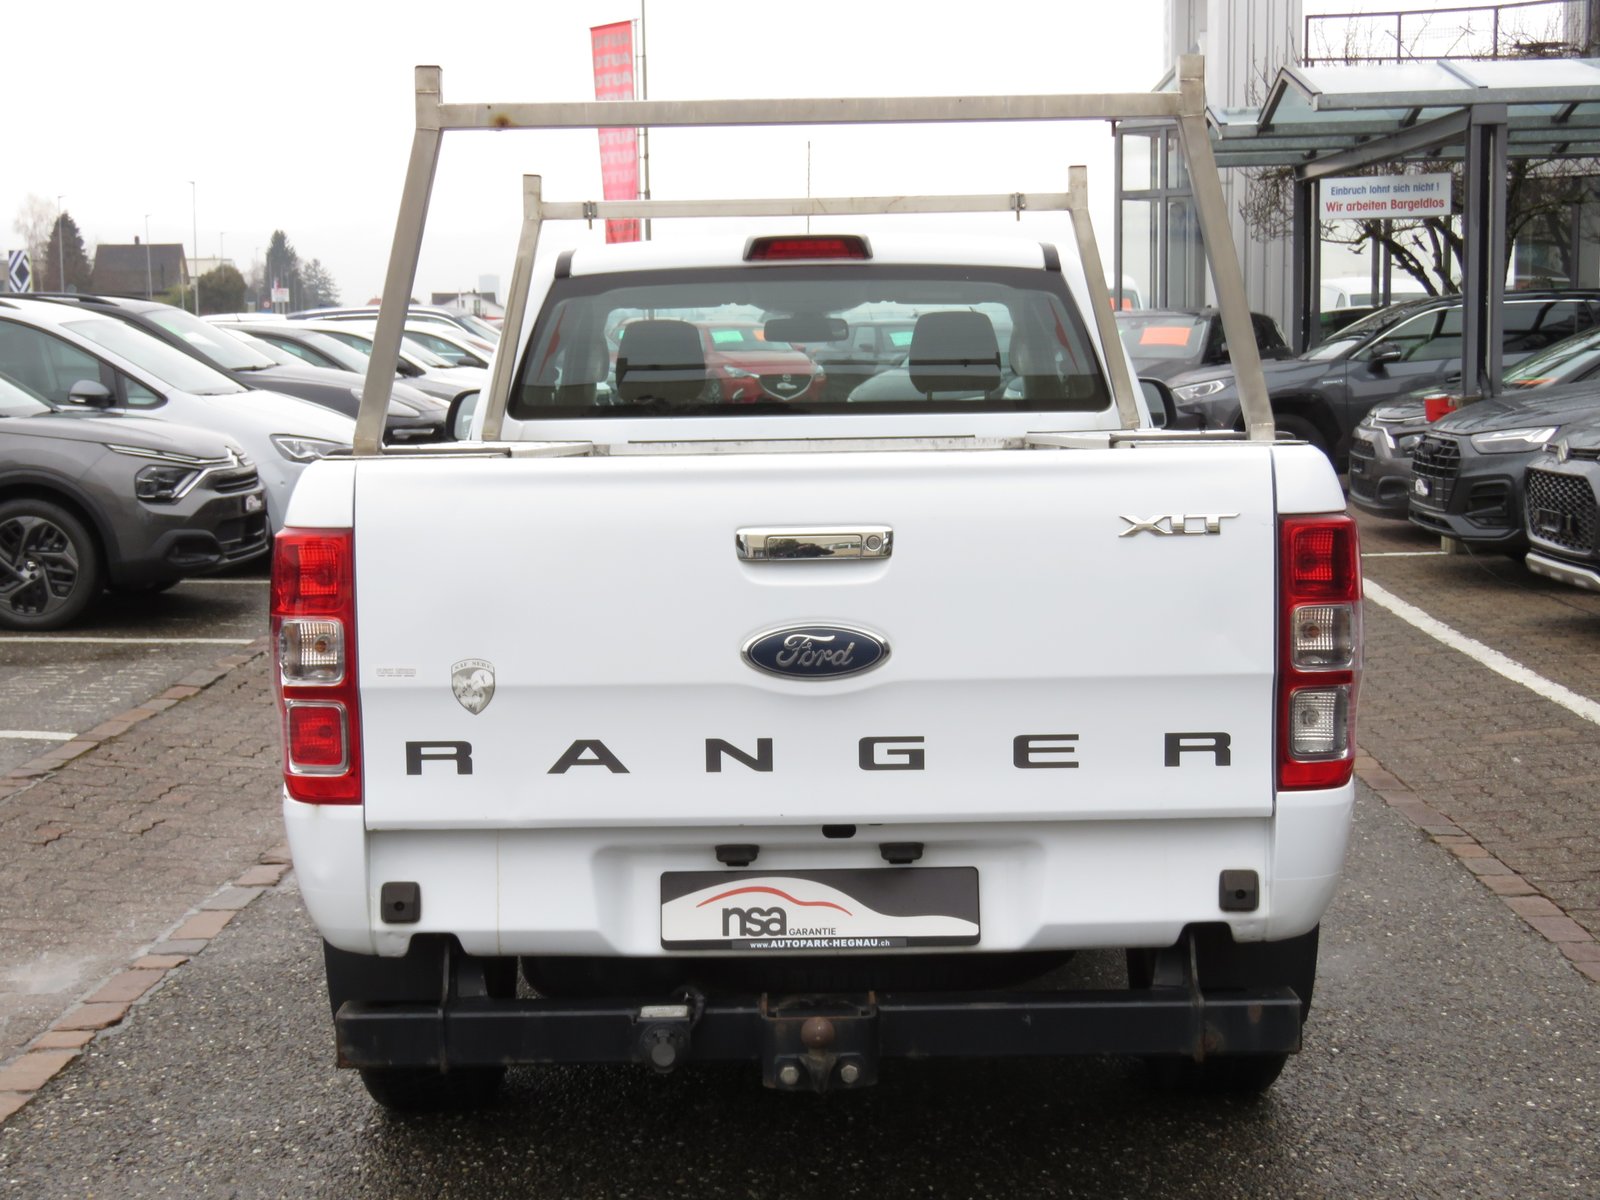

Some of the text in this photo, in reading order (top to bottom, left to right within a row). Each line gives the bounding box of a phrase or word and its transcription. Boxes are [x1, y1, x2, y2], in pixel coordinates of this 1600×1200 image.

[1330, 185, 1367, 196] Einbruch
[1369, 184, 1391, 194] lohnt
[1392, 183, 1411, 193] sich
[1413, 182, 1435, 192] nicht
[1326, 197, 1445, 212] Wir arbeiten Bargeldlos
[1118, 512, 1240, 538] XLT
[776, 633, 856, 667] Ford
[405, 732, 1231, 776] RANGER
[721, 906, 837, 937] nsa GARANTIE
[750, 937, 891, 950] www.AUTOPARK-HEGNAU.ch
